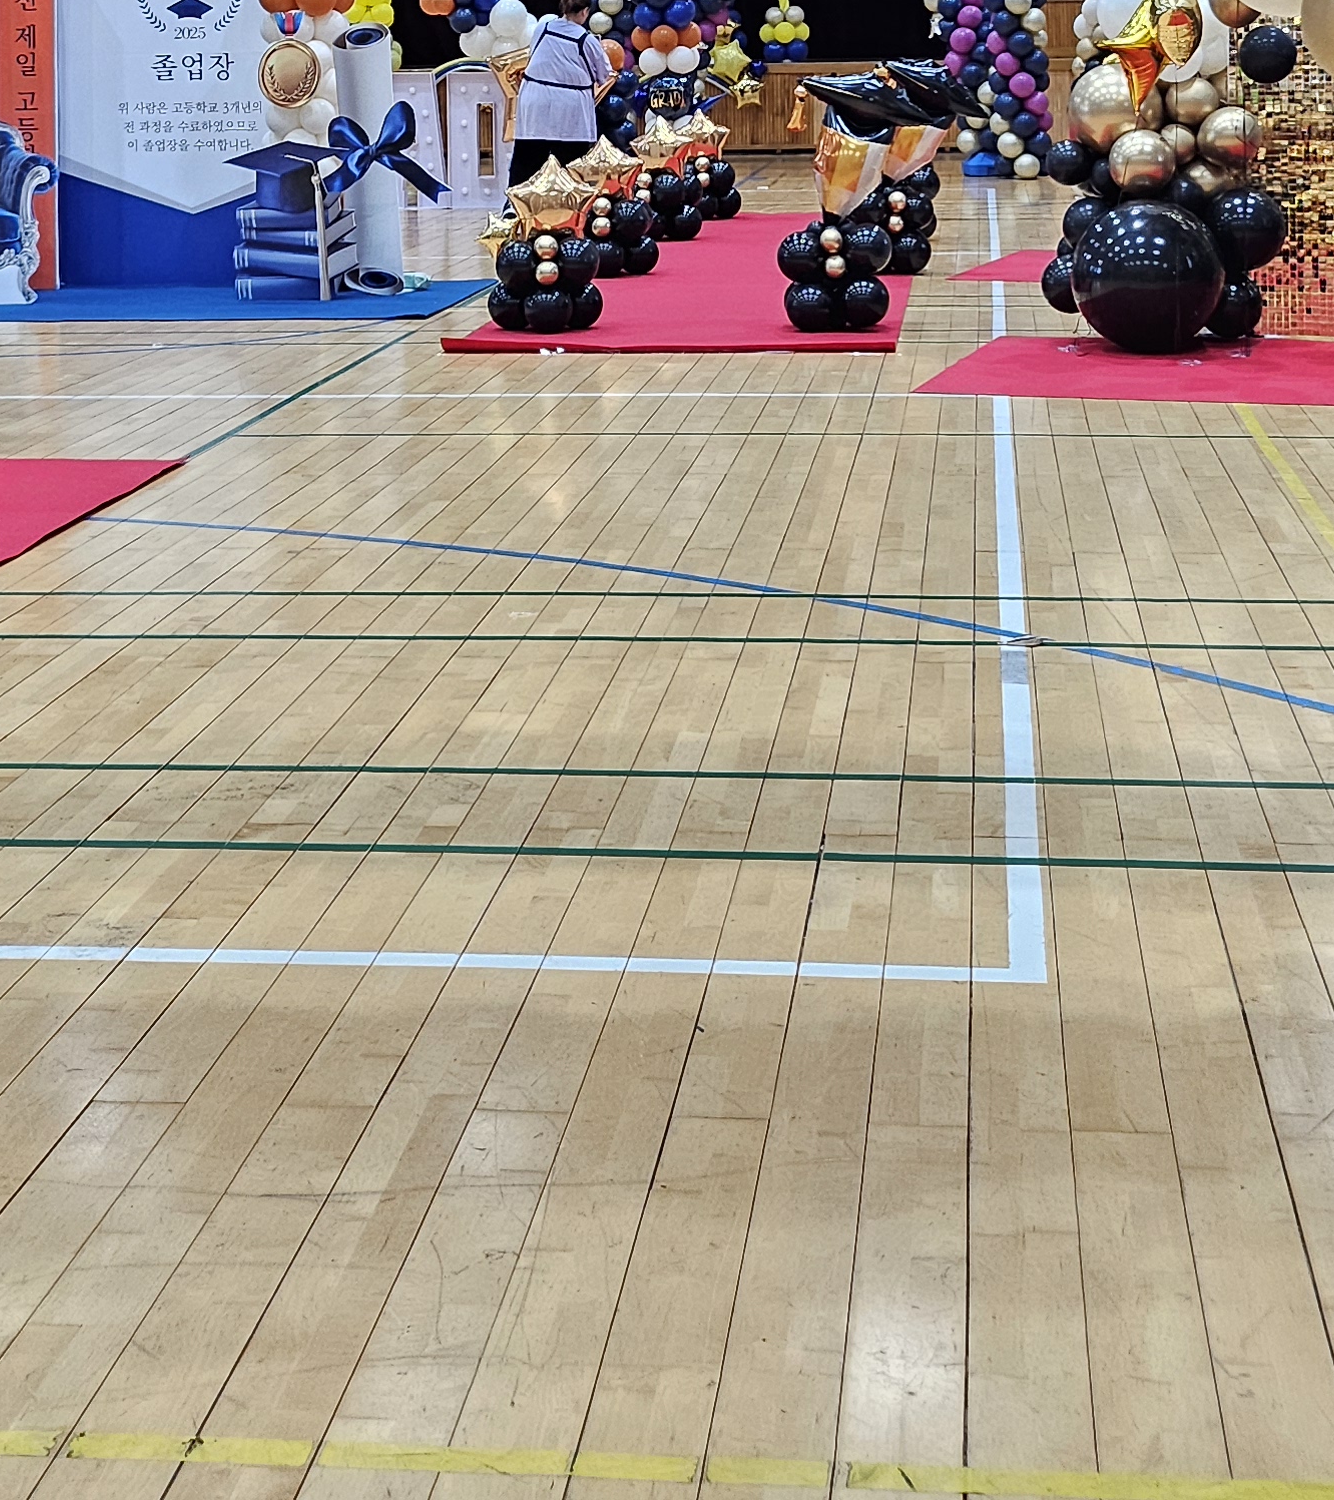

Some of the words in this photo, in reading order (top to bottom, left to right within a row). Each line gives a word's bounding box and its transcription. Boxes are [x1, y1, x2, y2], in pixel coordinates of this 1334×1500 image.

[173, 26, 207, 40] 2025
[14, 24, 38, 77] 제일
[150, 52, 235, 81] 졸업장
[117, 101, 129, 115] 위
[132, 101, 169, 115] 사람은
[171, 101, 219, 115] 고등학교
[222, 100, 263, 115] 3개년의
[14, 91, 39, 154] 고등
[123, 120, 136, 134] 전
[138, 120, 175, 134] 과정을
[177, 120, 259, 133] 수료하였으므로
[127, 138, 139, 152] 이
[142, 138, 190, 152] 졸업장을
[193, 138, 255, 152] 수여합니다.
